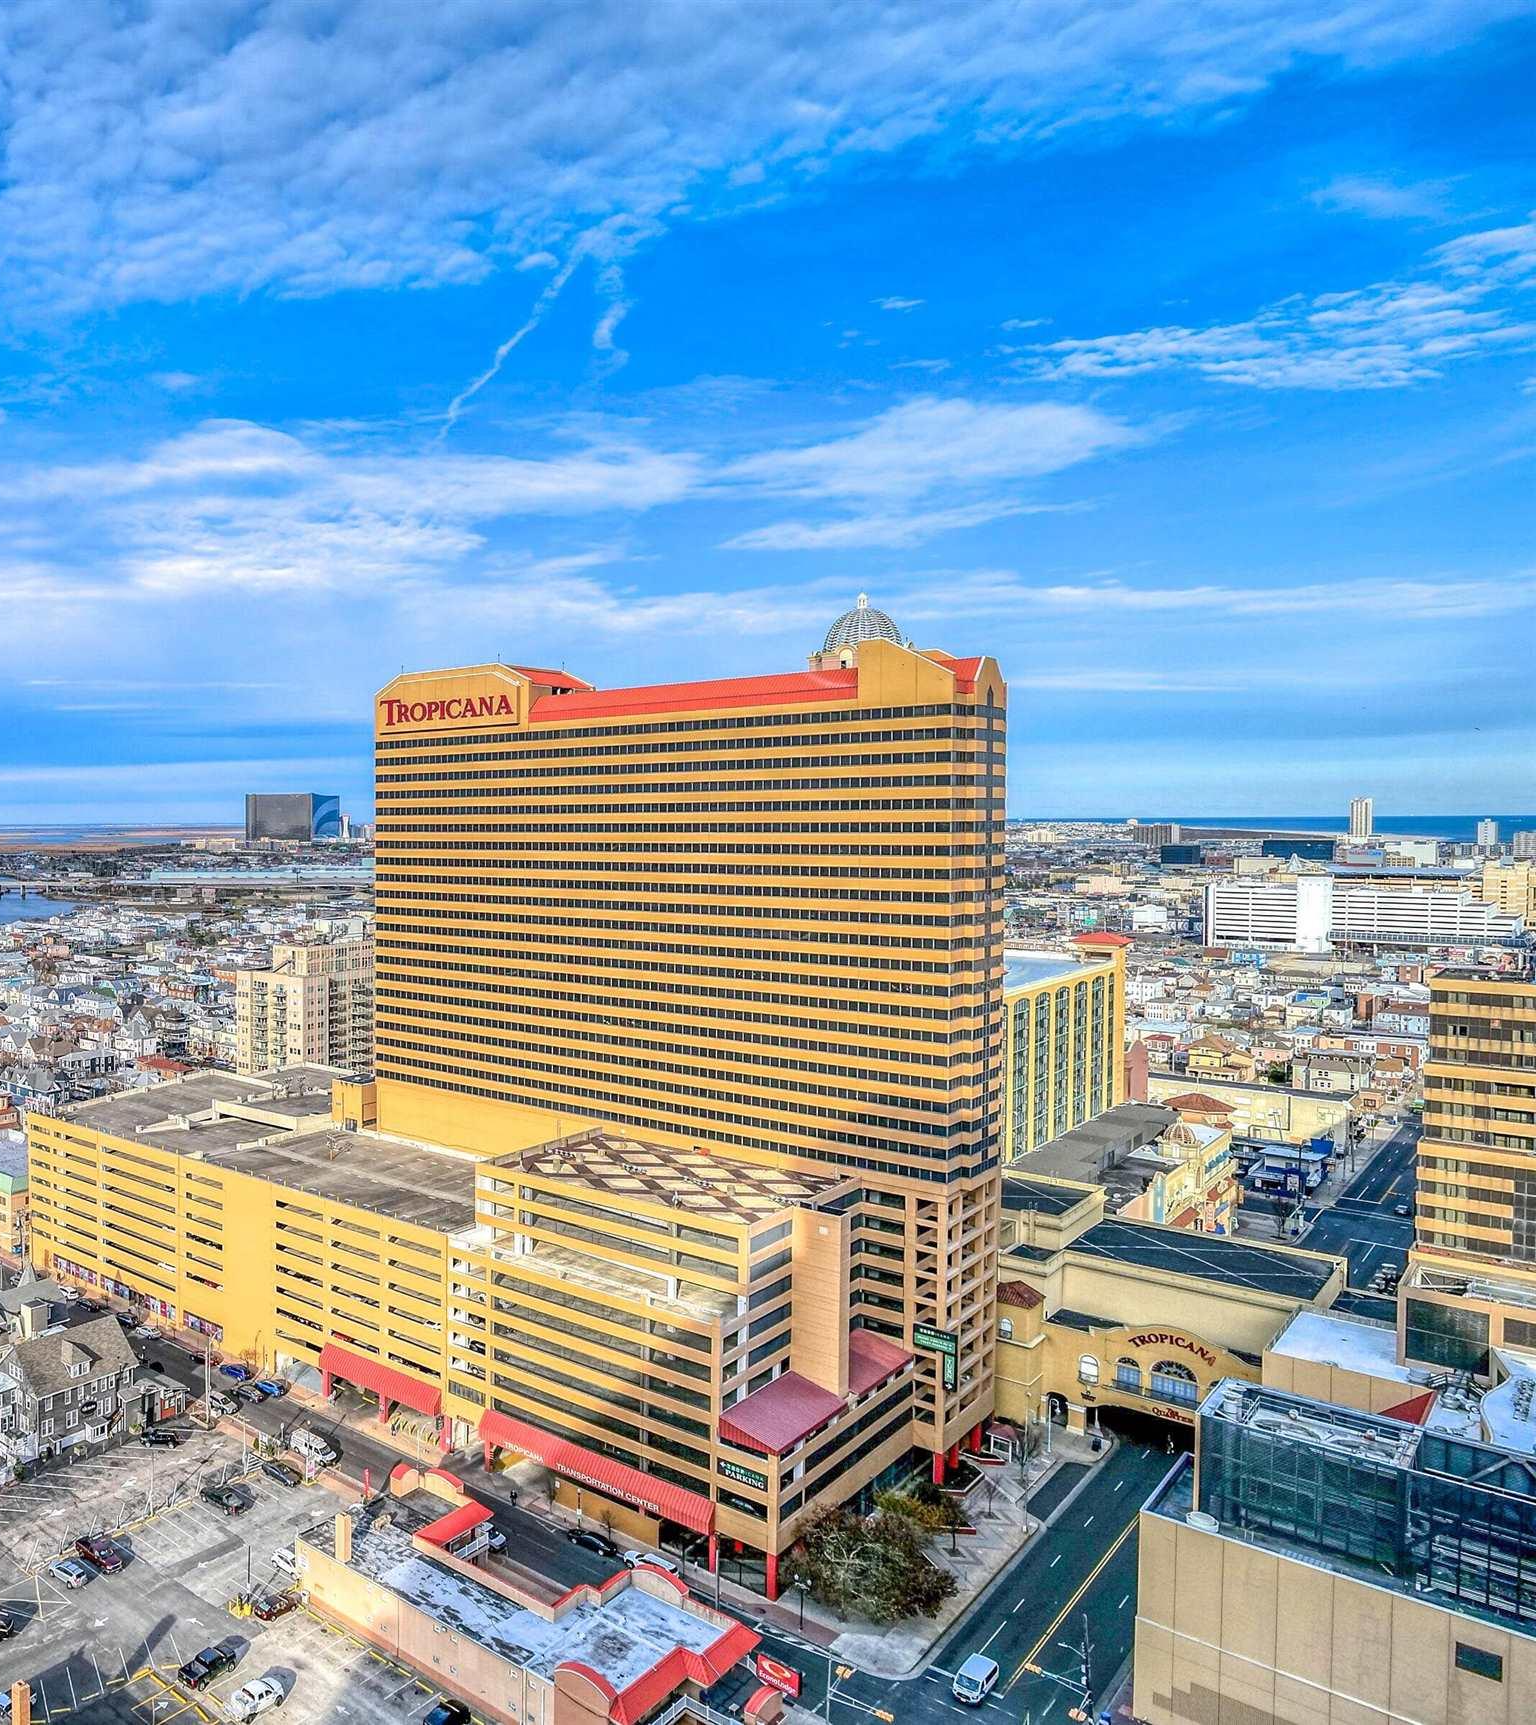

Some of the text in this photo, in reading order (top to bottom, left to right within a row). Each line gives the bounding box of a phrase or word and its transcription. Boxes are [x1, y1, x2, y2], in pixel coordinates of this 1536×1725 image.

[379, 694, 514, 726] TROPICANA
[1128, 1333, 1217, 1367] TROPICANA
[503, 1441, 660, 1512] TROPICANA TRANSPORTATION CENTER
[724, 1469, 765, 1489] PARKING
